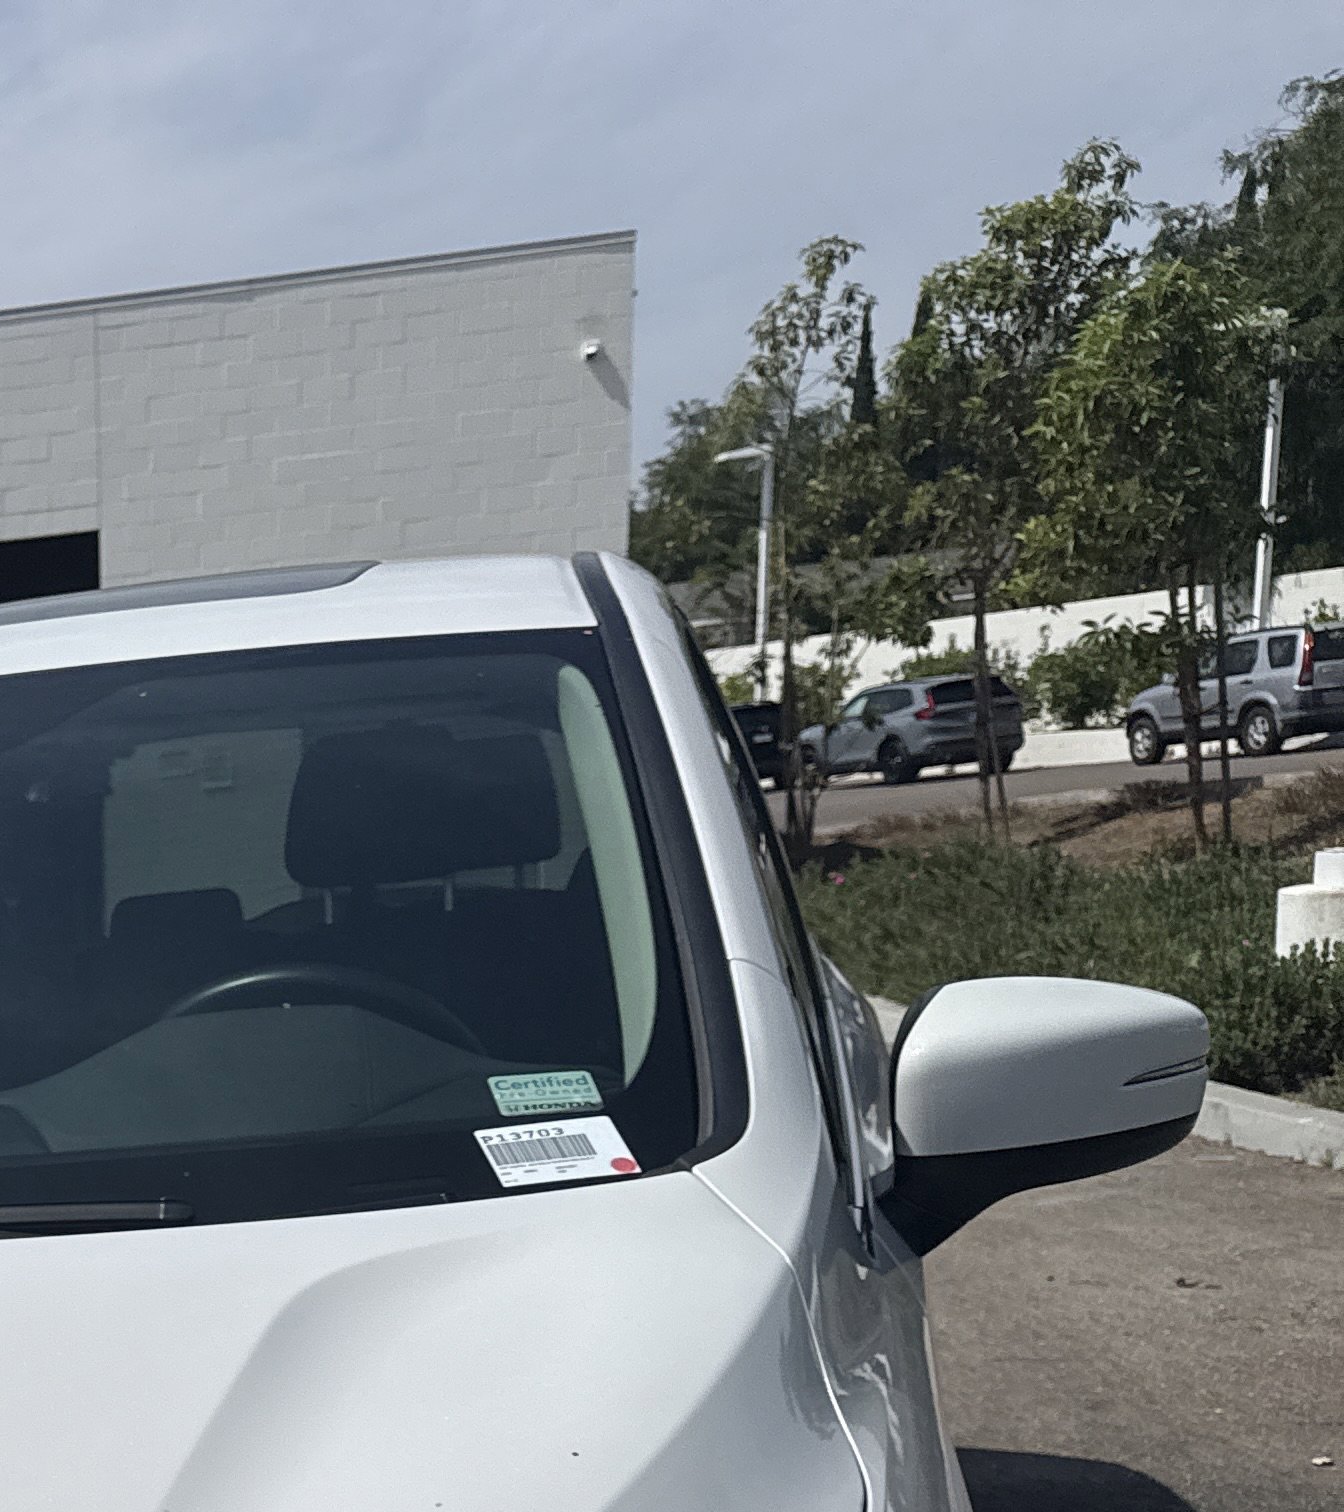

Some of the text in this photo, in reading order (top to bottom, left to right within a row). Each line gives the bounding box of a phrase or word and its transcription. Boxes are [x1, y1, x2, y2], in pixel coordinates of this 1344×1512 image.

[494, 1075, 589, 1091] Certified
[523, 1101, 598, 1111] HONDA
[480, 1127, 564, 1144] P13703
